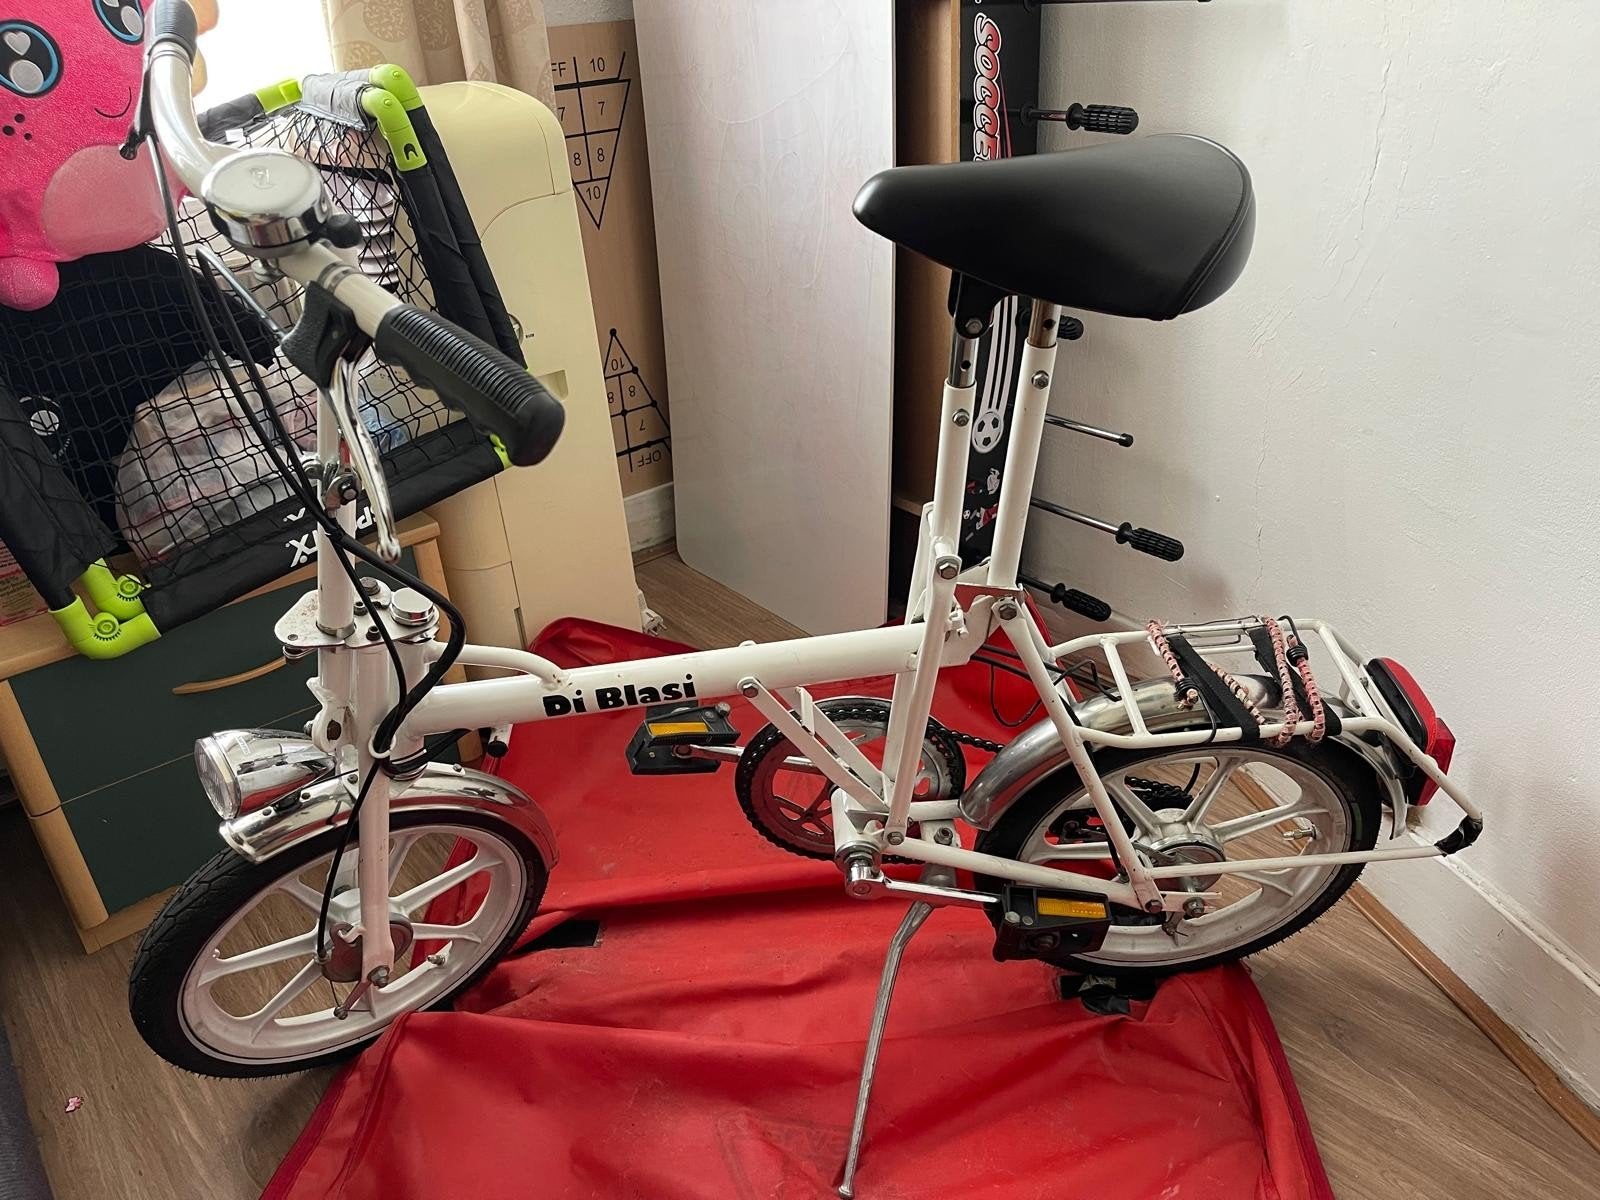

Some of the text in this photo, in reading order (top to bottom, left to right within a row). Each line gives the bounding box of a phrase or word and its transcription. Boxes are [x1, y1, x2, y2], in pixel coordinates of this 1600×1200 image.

[589, 56, 606, 73] 10
[973, 12, 1002, 162] SOCCE
[557, 101, 606, 122] 7 7
[573, 147, 605, 167] 8 8
[585, 185, 601, 201] 10
[611, 357, 625, 371] 10
[607, 391, 614, 403] 8
[628, 385, 636, 397] 8
[639, 419, 646, 431] 7
[637, 450, 662, 467] OFF
[542, 673, 697, 717] Di Blasi
